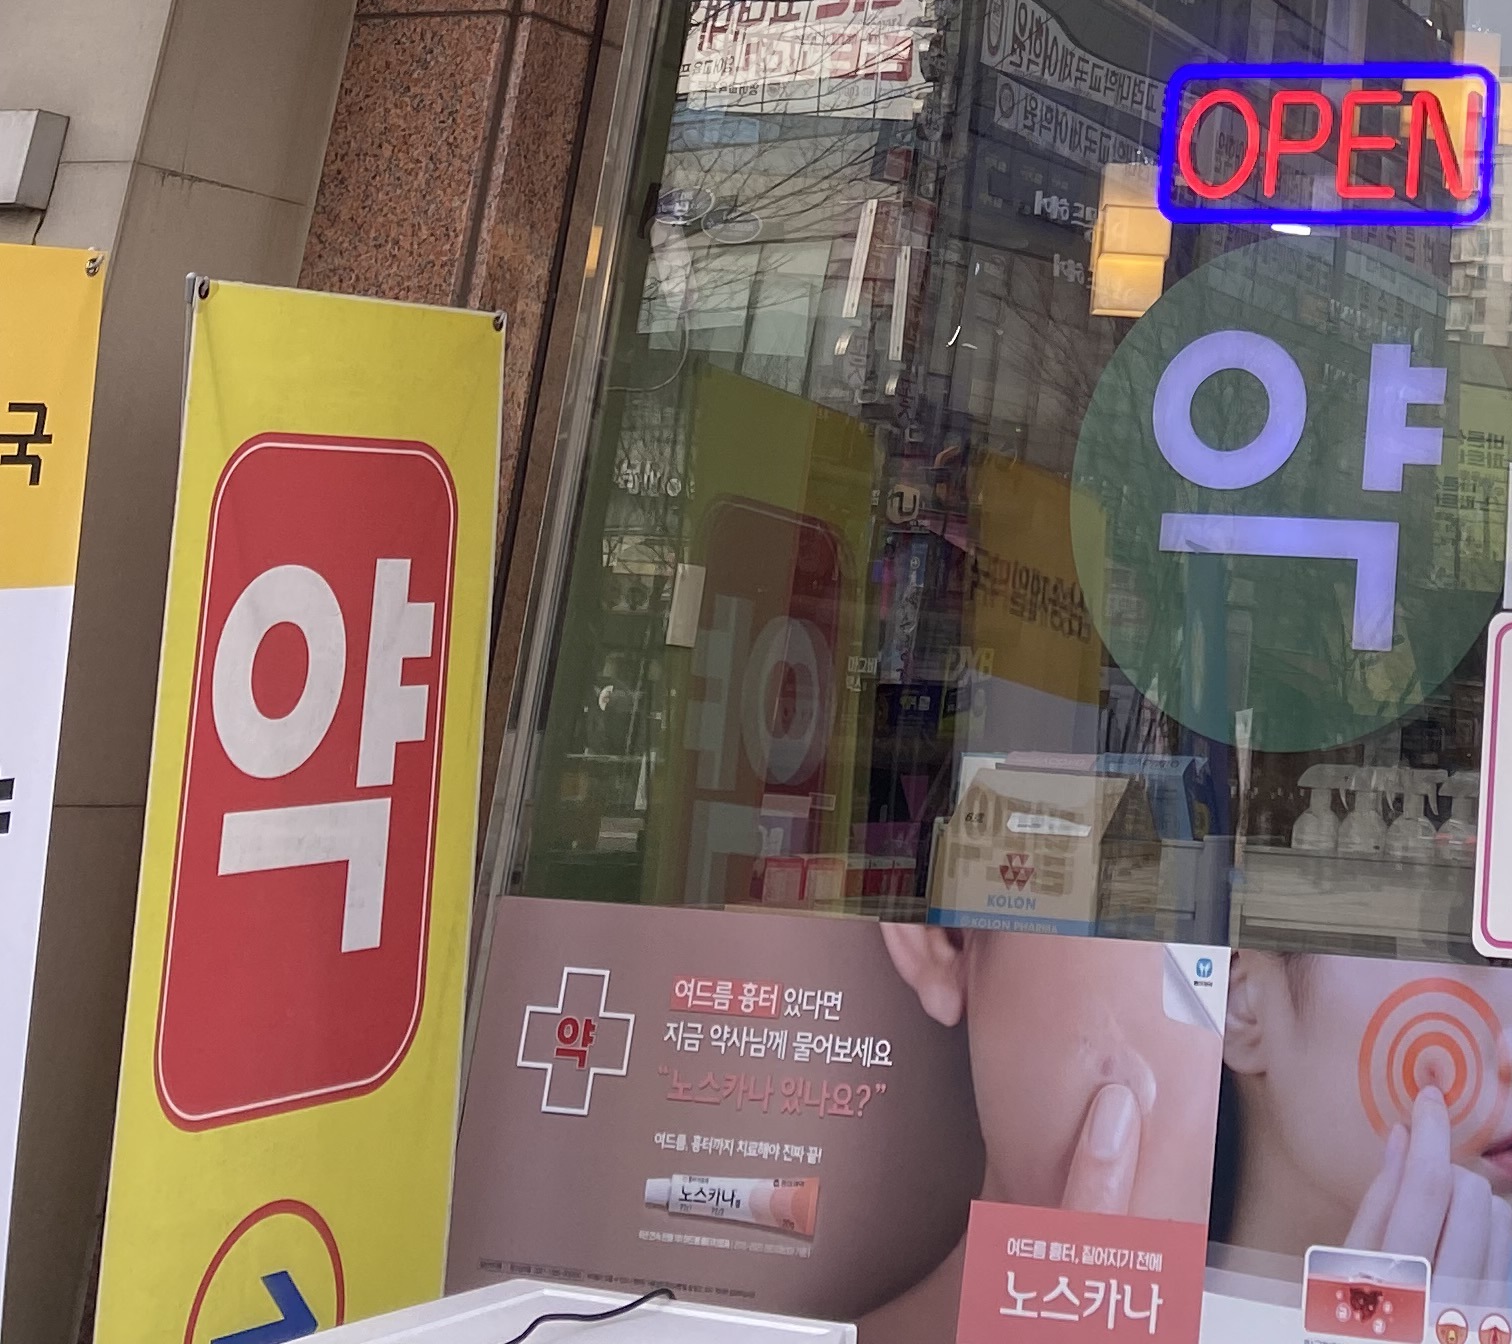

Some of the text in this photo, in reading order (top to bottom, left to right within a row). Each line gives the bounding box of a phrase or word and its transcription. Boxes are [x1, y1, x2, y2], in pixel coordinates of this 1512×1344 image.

[1178, 89, 1484, 200] OPEN
[1153, 329, 1448, 651] 약
[212, 558, 435, 954] 약
[987, 894, 1036, 911] KOLON
[675, 978, 843, 1020] 여드름 흉터 있다면
[556, 1015, 595, 1069] 약
[664, 1021, 893, 1067] 지금 약사님께 물어보세요
[679, 1185, 735, 1209] 노스카나
[1136, 1251, 1162, 1272] 전에
[1000, 1270, 1163, 1334] 노스카나
